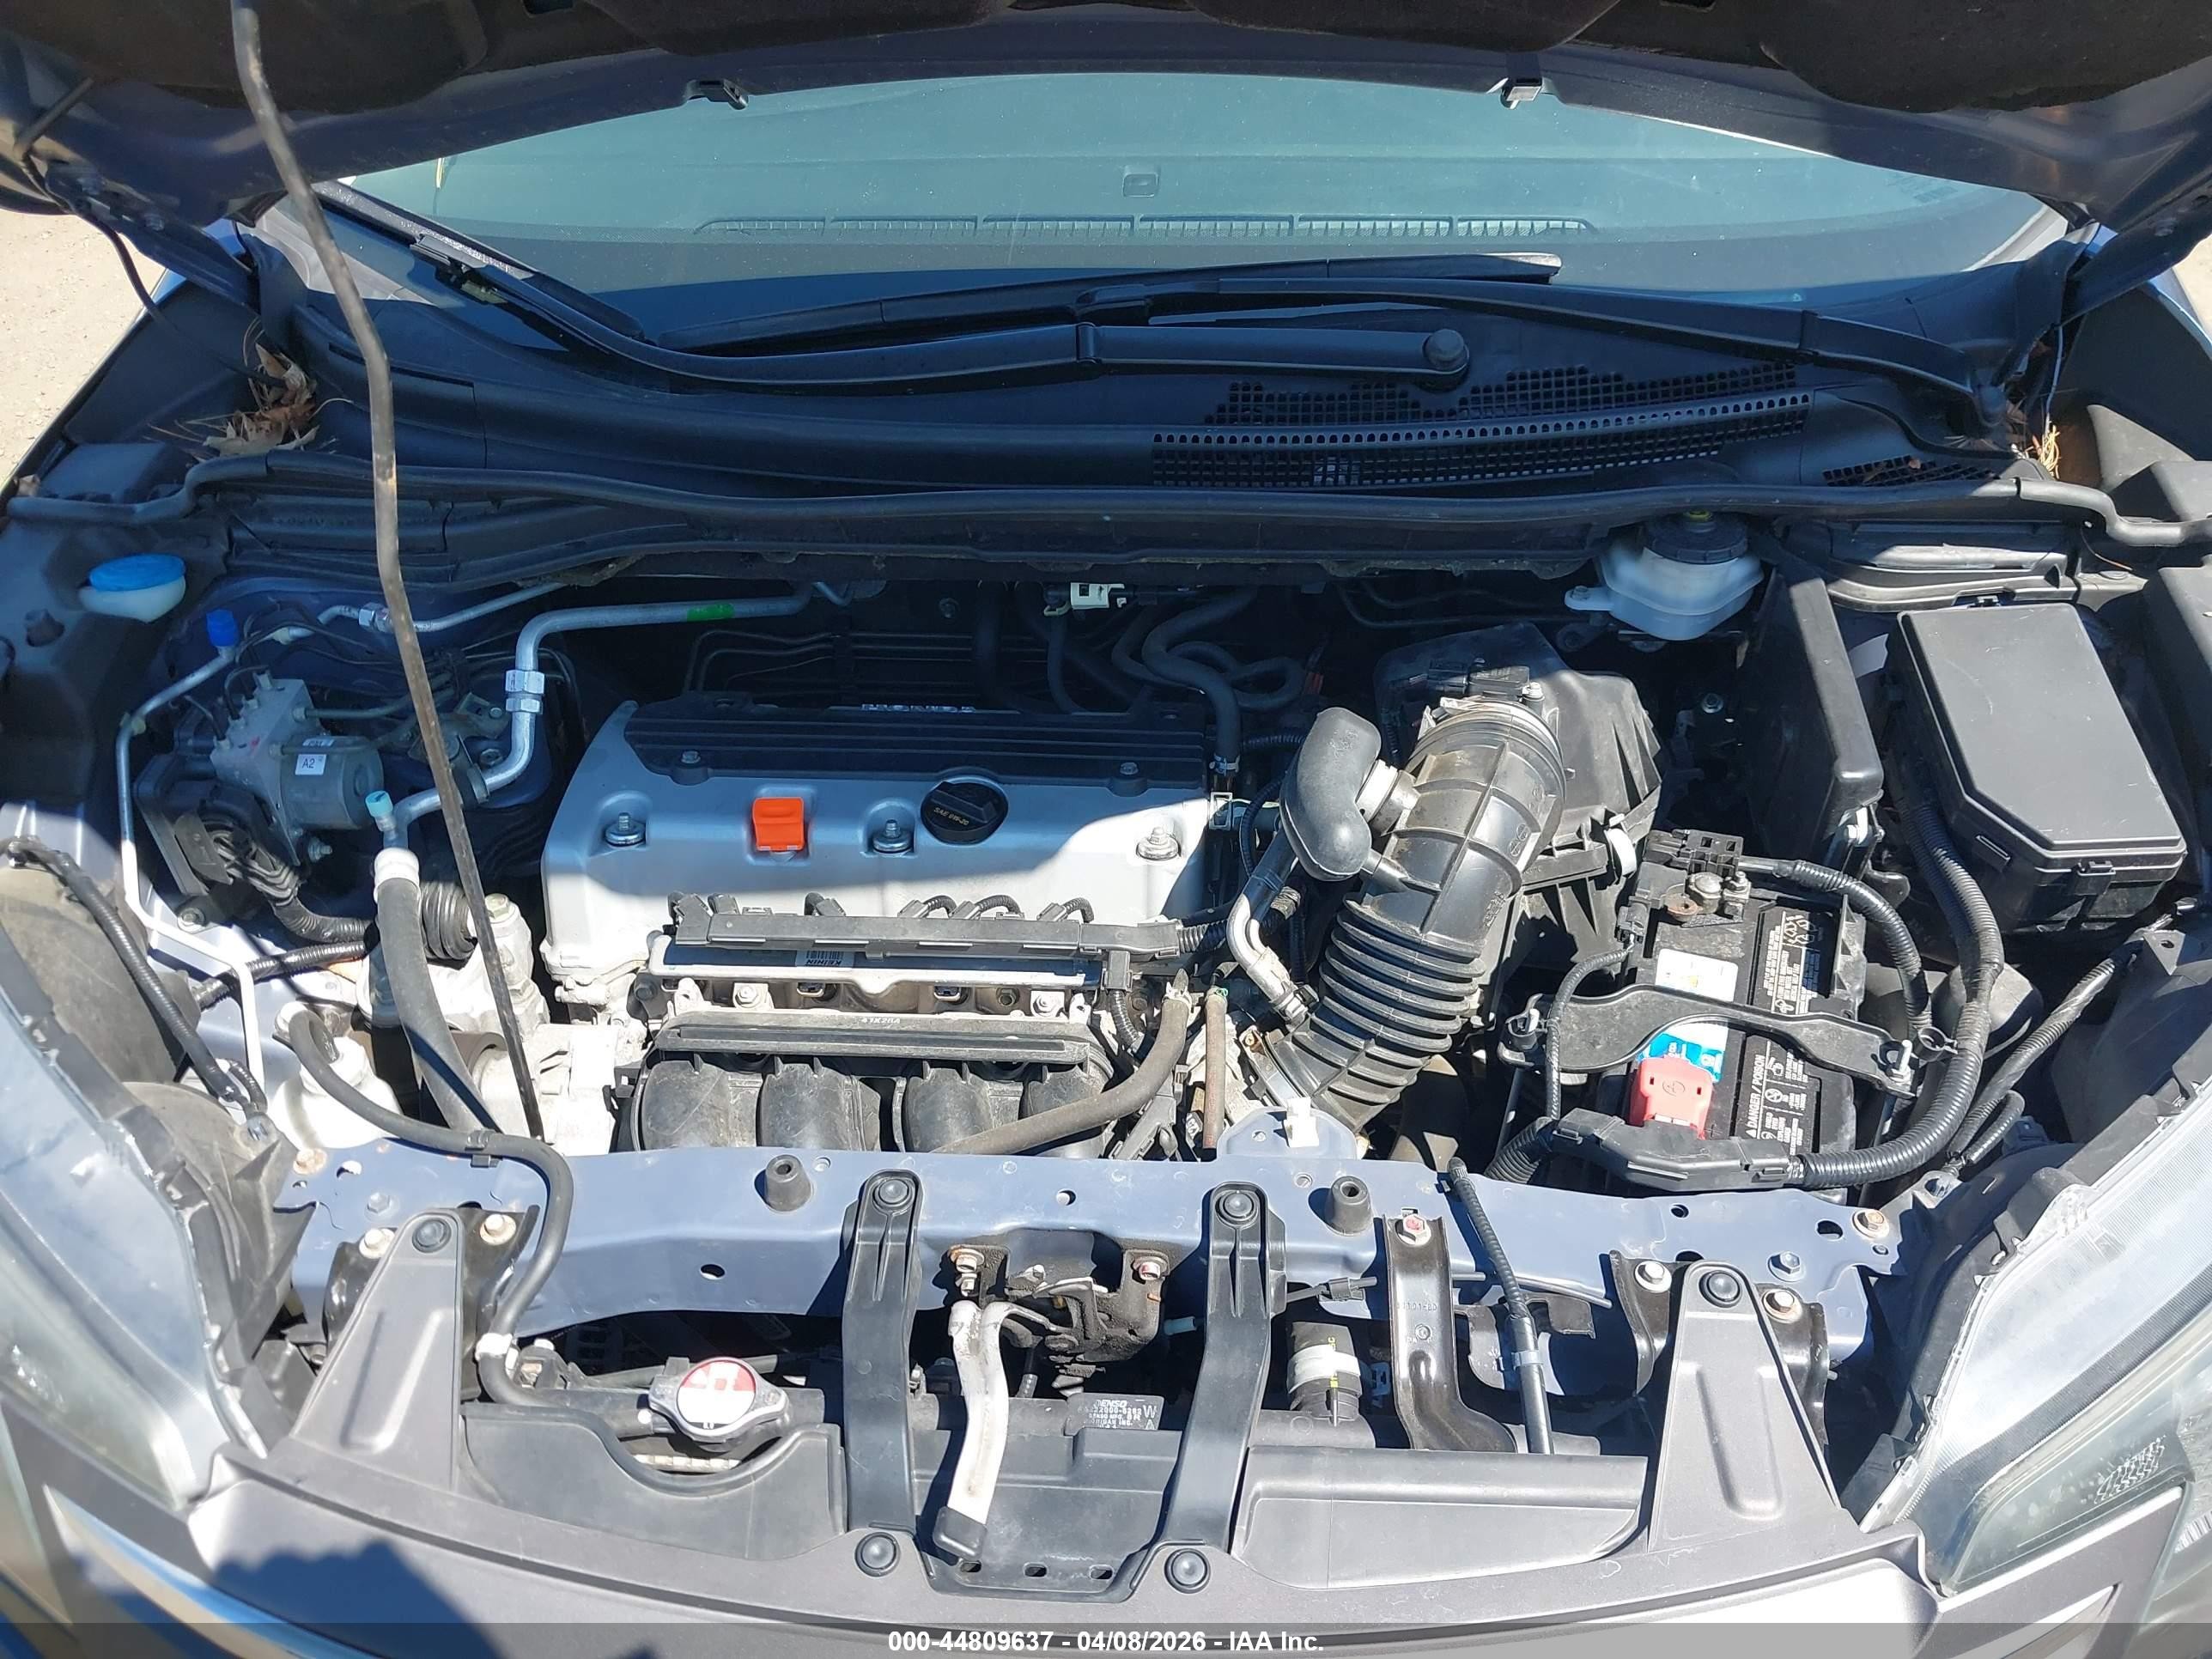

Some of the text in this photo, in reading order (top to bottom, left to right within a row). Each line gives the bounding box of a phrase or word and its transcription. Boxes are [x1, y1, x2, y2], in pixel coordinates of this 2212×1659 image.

[861, 703, 976, 714] HONDA
[301, 757, 315, 769] A2
[933, 807, 950, 817] SAE
[1753, 1054, 1765, 1085] POISON
[1747, 1092, 1760, 1128] DANGER
[1096, 1399, 1127, 1408] DENSO
